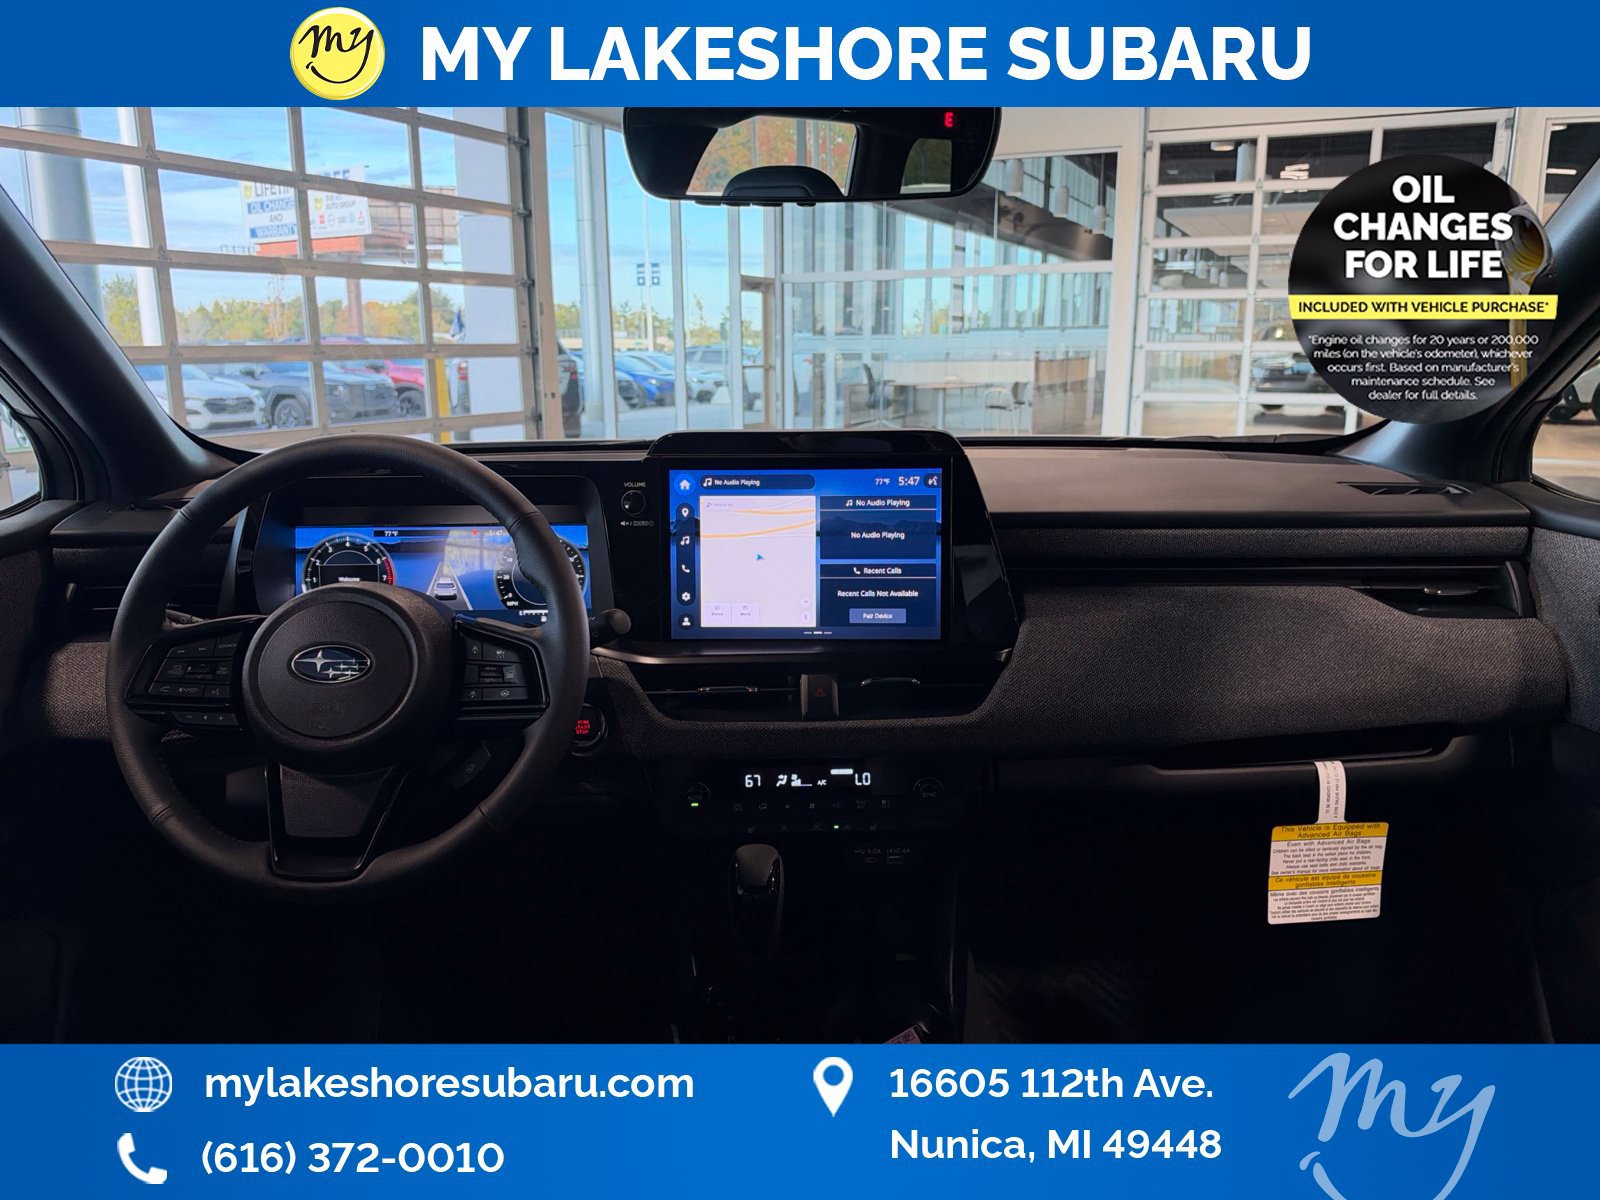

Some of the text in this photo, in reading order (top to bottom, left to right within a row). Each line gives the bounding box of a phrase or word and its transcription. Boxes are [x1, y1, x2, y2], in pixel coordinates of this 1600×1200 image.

[944, 111, 954, 127] E
[741, 479, 761, 487] Playing
[898, 476, 921, 486] 5:47
[855, 499, 911, 508] No Audio Playing
[850, 531, 906, 540] No Audio Playing
[863, 567, 902, 575] Recent Calls
[744, 774, 761, 788] 67
[854, 772, 871, 786] LO
[1333, 823, 1365, 831] Equipped
[1345, 830, 1362, 838] Bags
